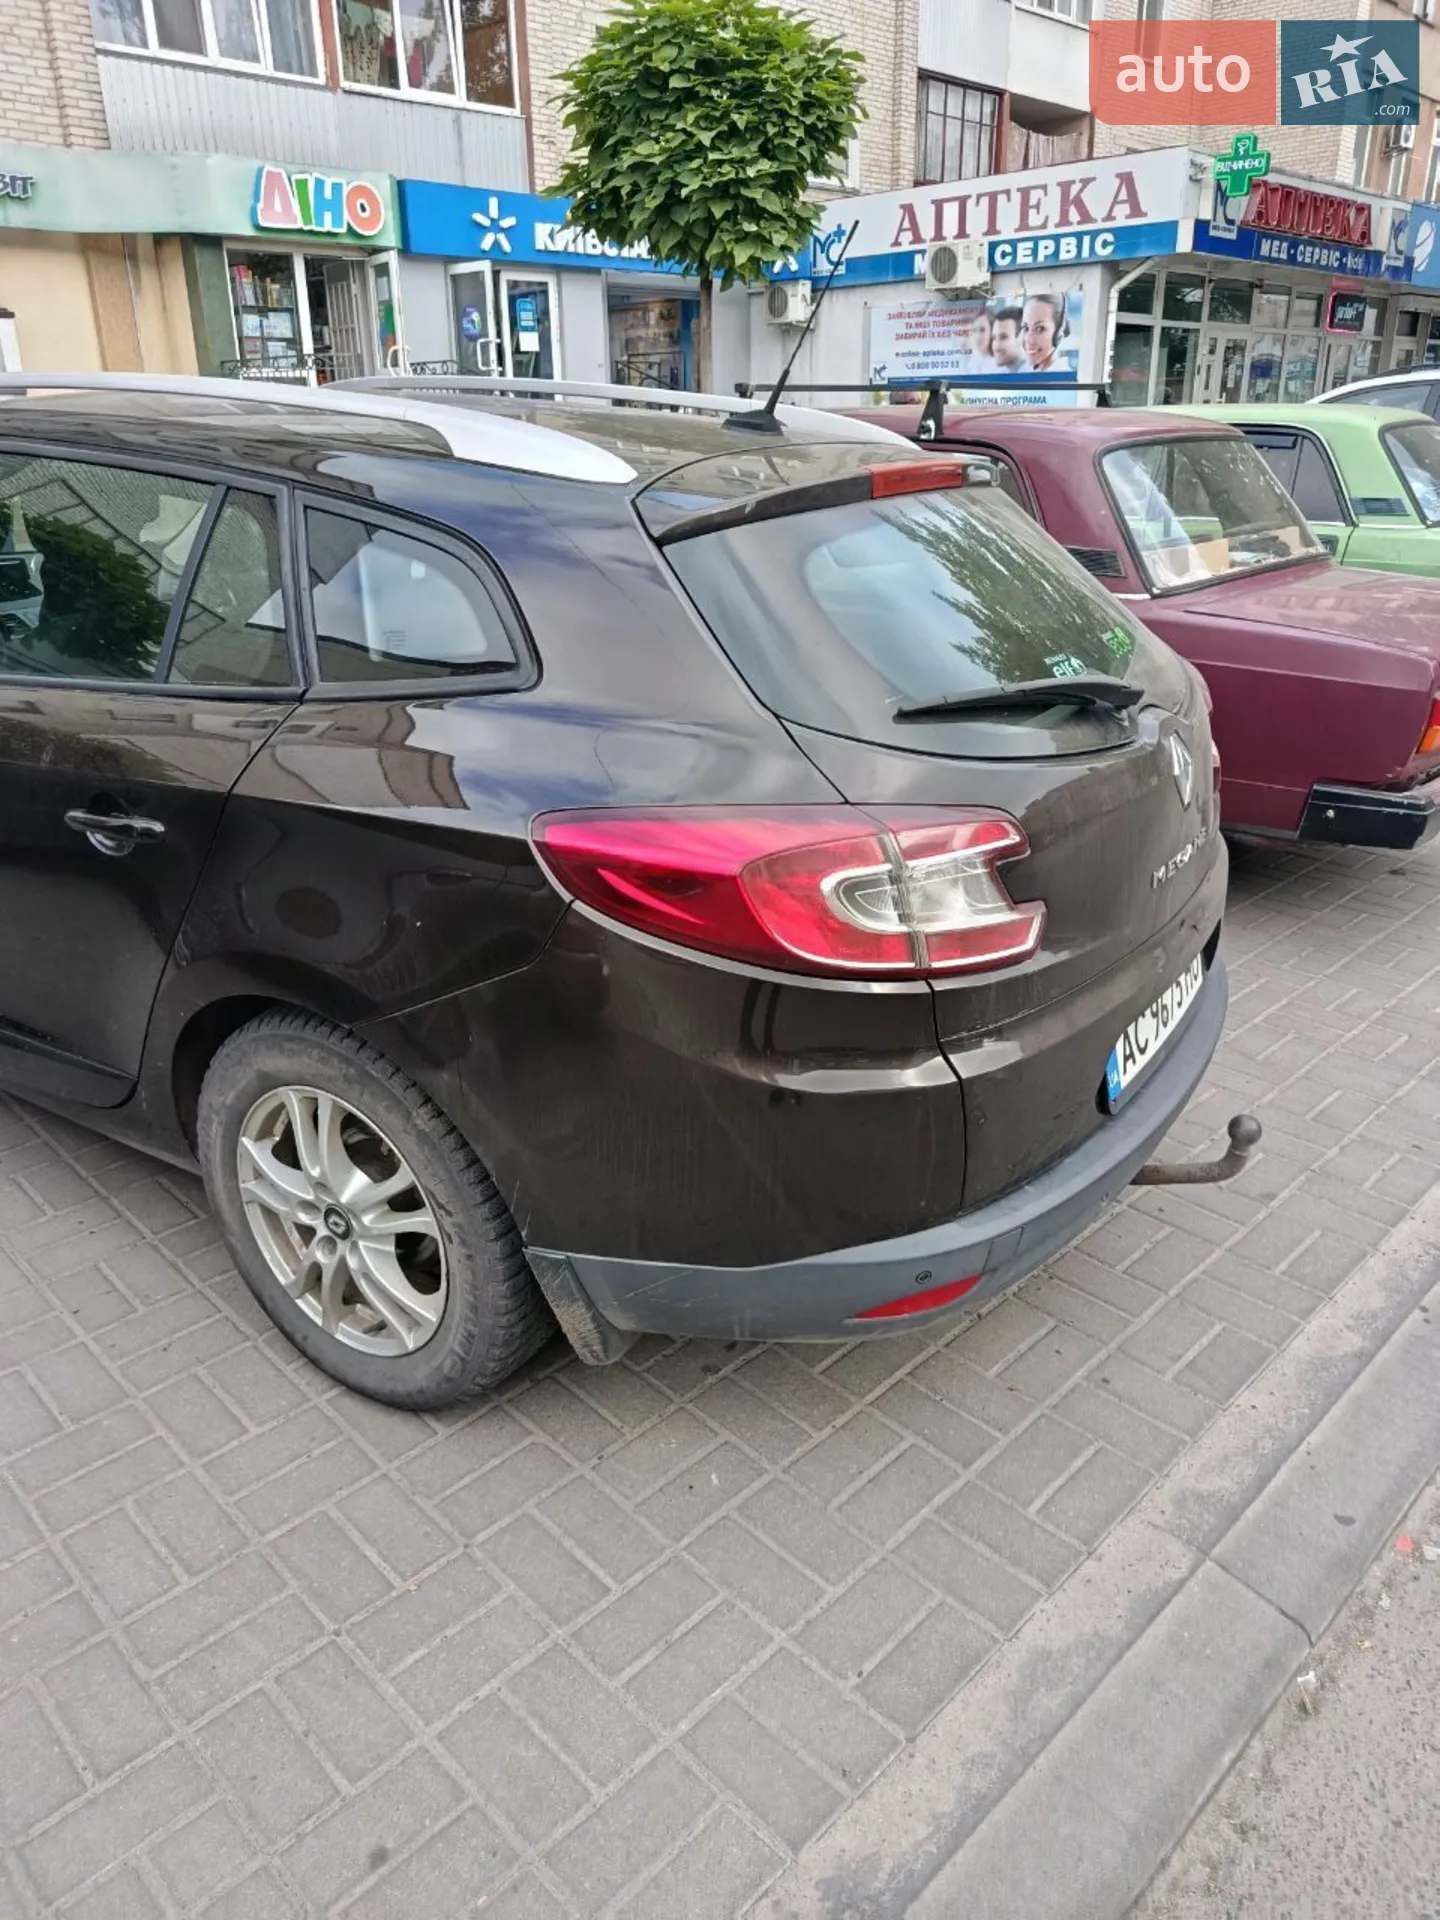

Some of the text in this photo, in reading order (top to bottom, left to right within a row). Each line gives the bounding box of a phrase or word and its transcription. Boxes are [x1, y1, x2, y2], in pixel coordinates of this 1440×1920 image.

[252, 166, 385, 236] ДІНО
[890, 171, 1148, 248] АПТЕКА
[1239, 179, 1372, 247] АПТЕКА
[994, 232, 1116, 267] СЕРВІС
[1296, 244, 1341, 268] СЕРВІС
